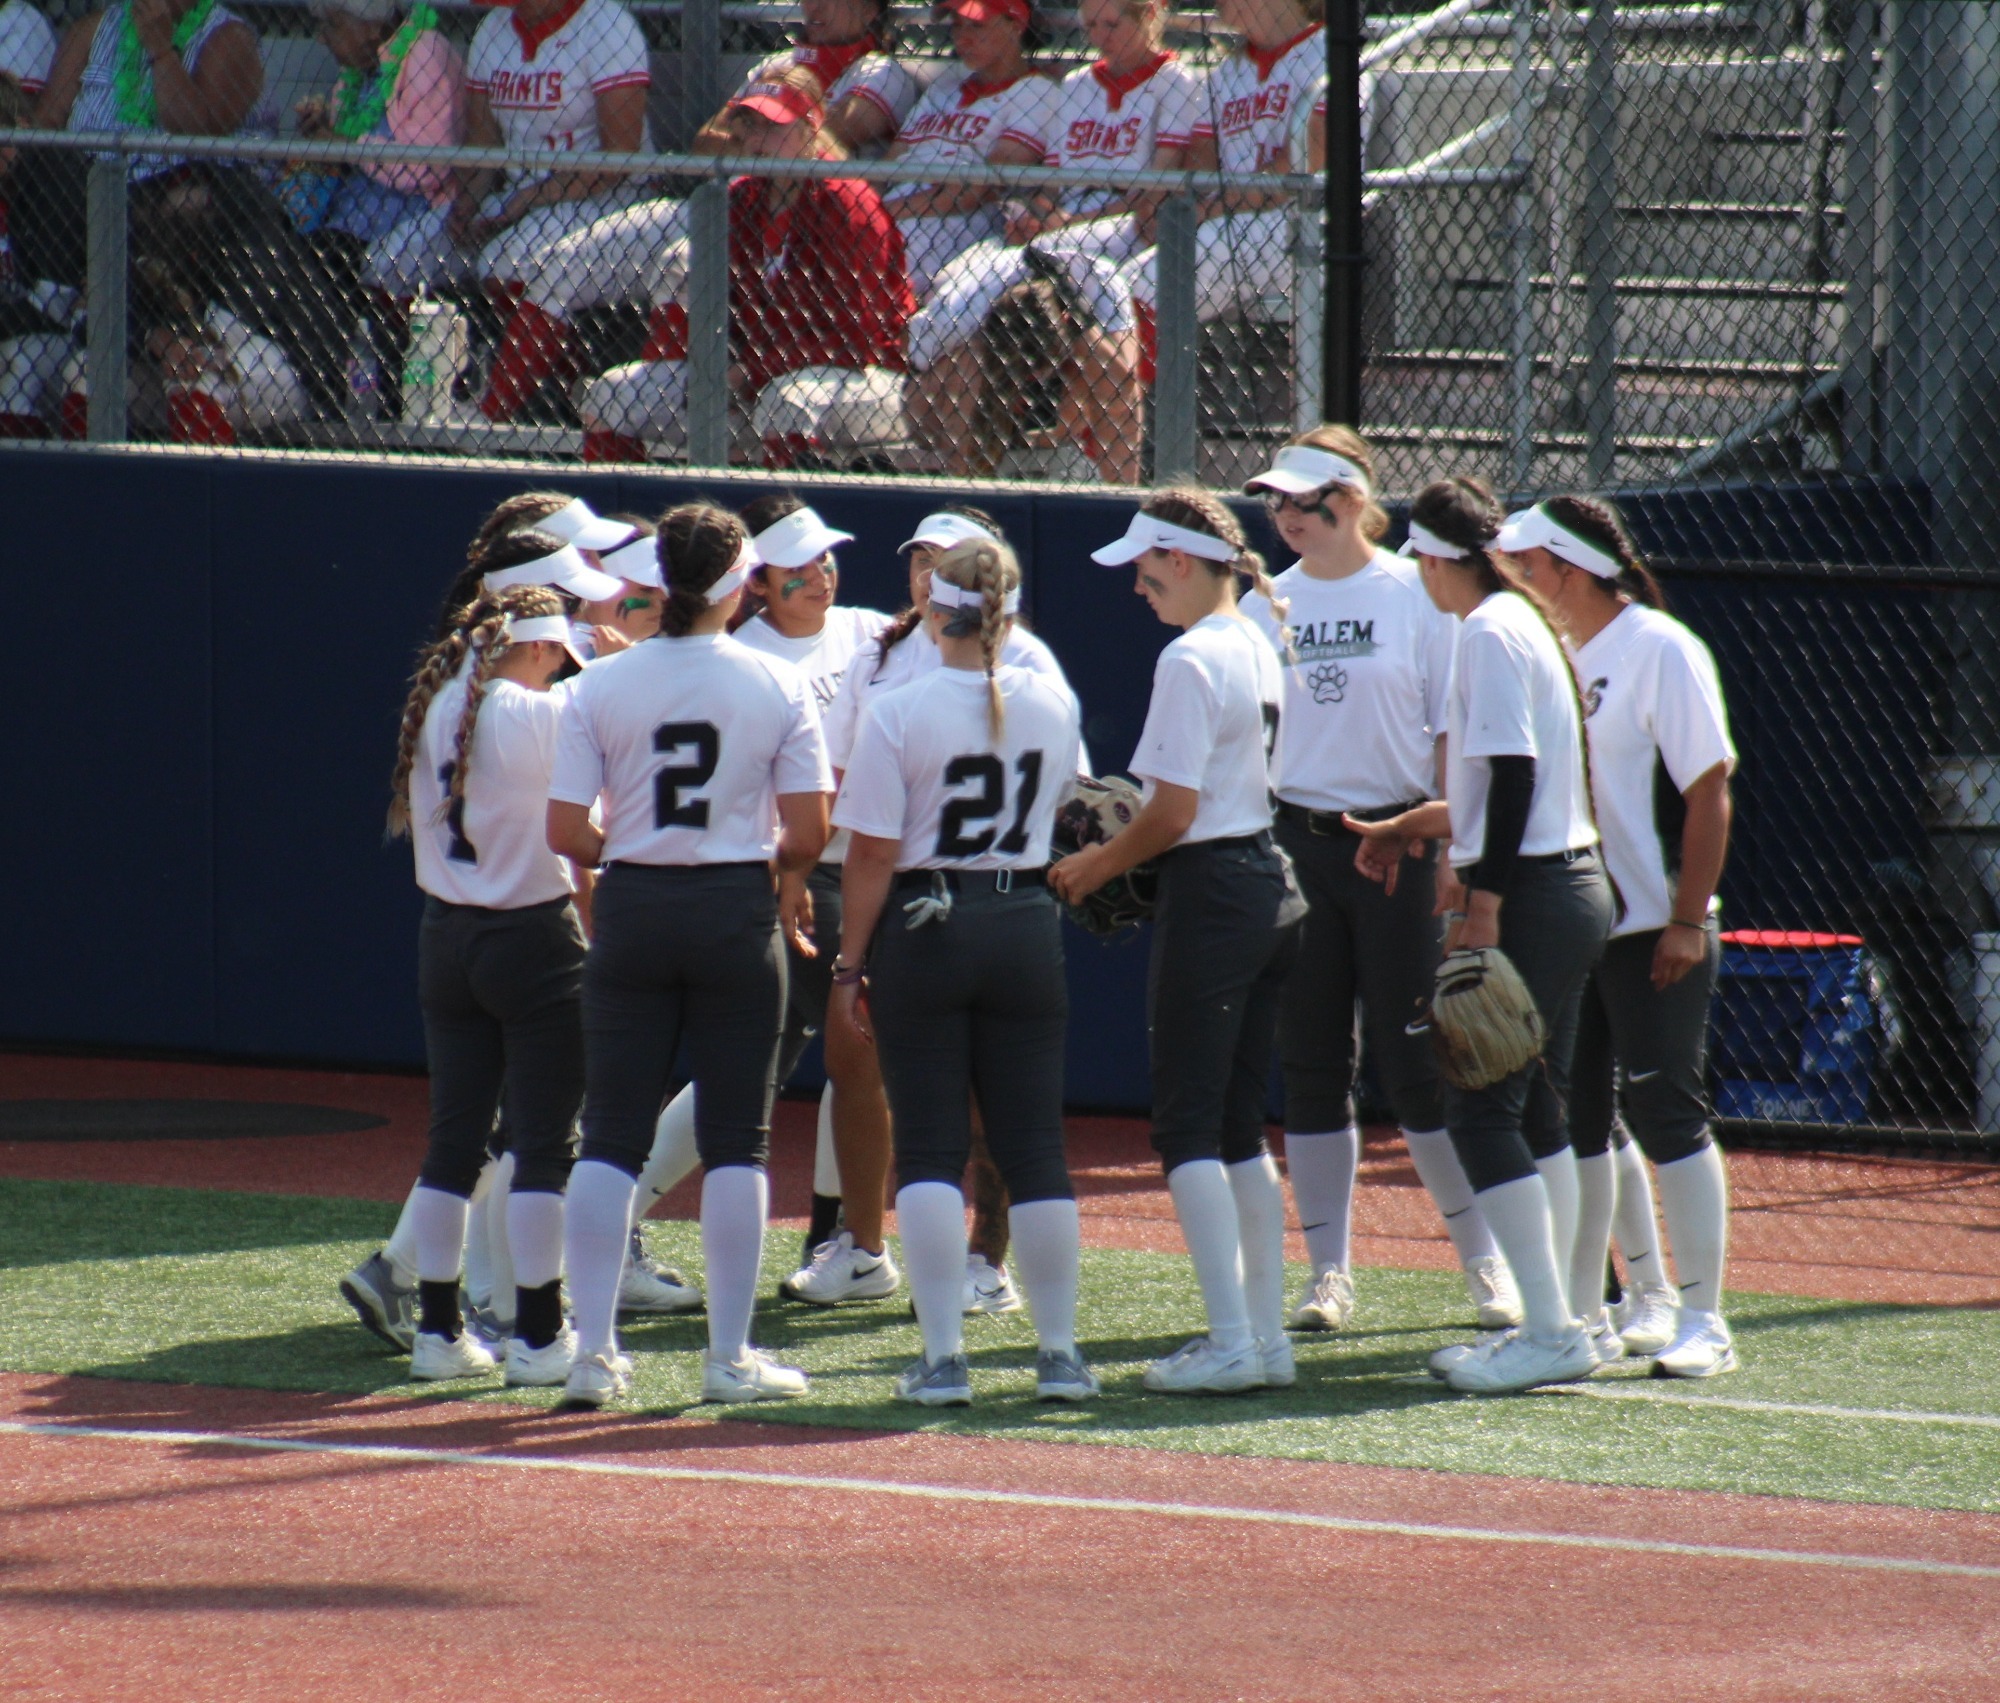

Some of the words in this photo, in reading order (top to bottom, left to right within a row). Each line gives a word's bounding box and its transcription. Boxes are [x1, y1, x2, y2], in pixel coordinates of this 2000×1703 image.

[1065, 117, 1142, 152] SAINS
[651, 719, 720, 831] 2
[932, 748, 1043, 860] 21
